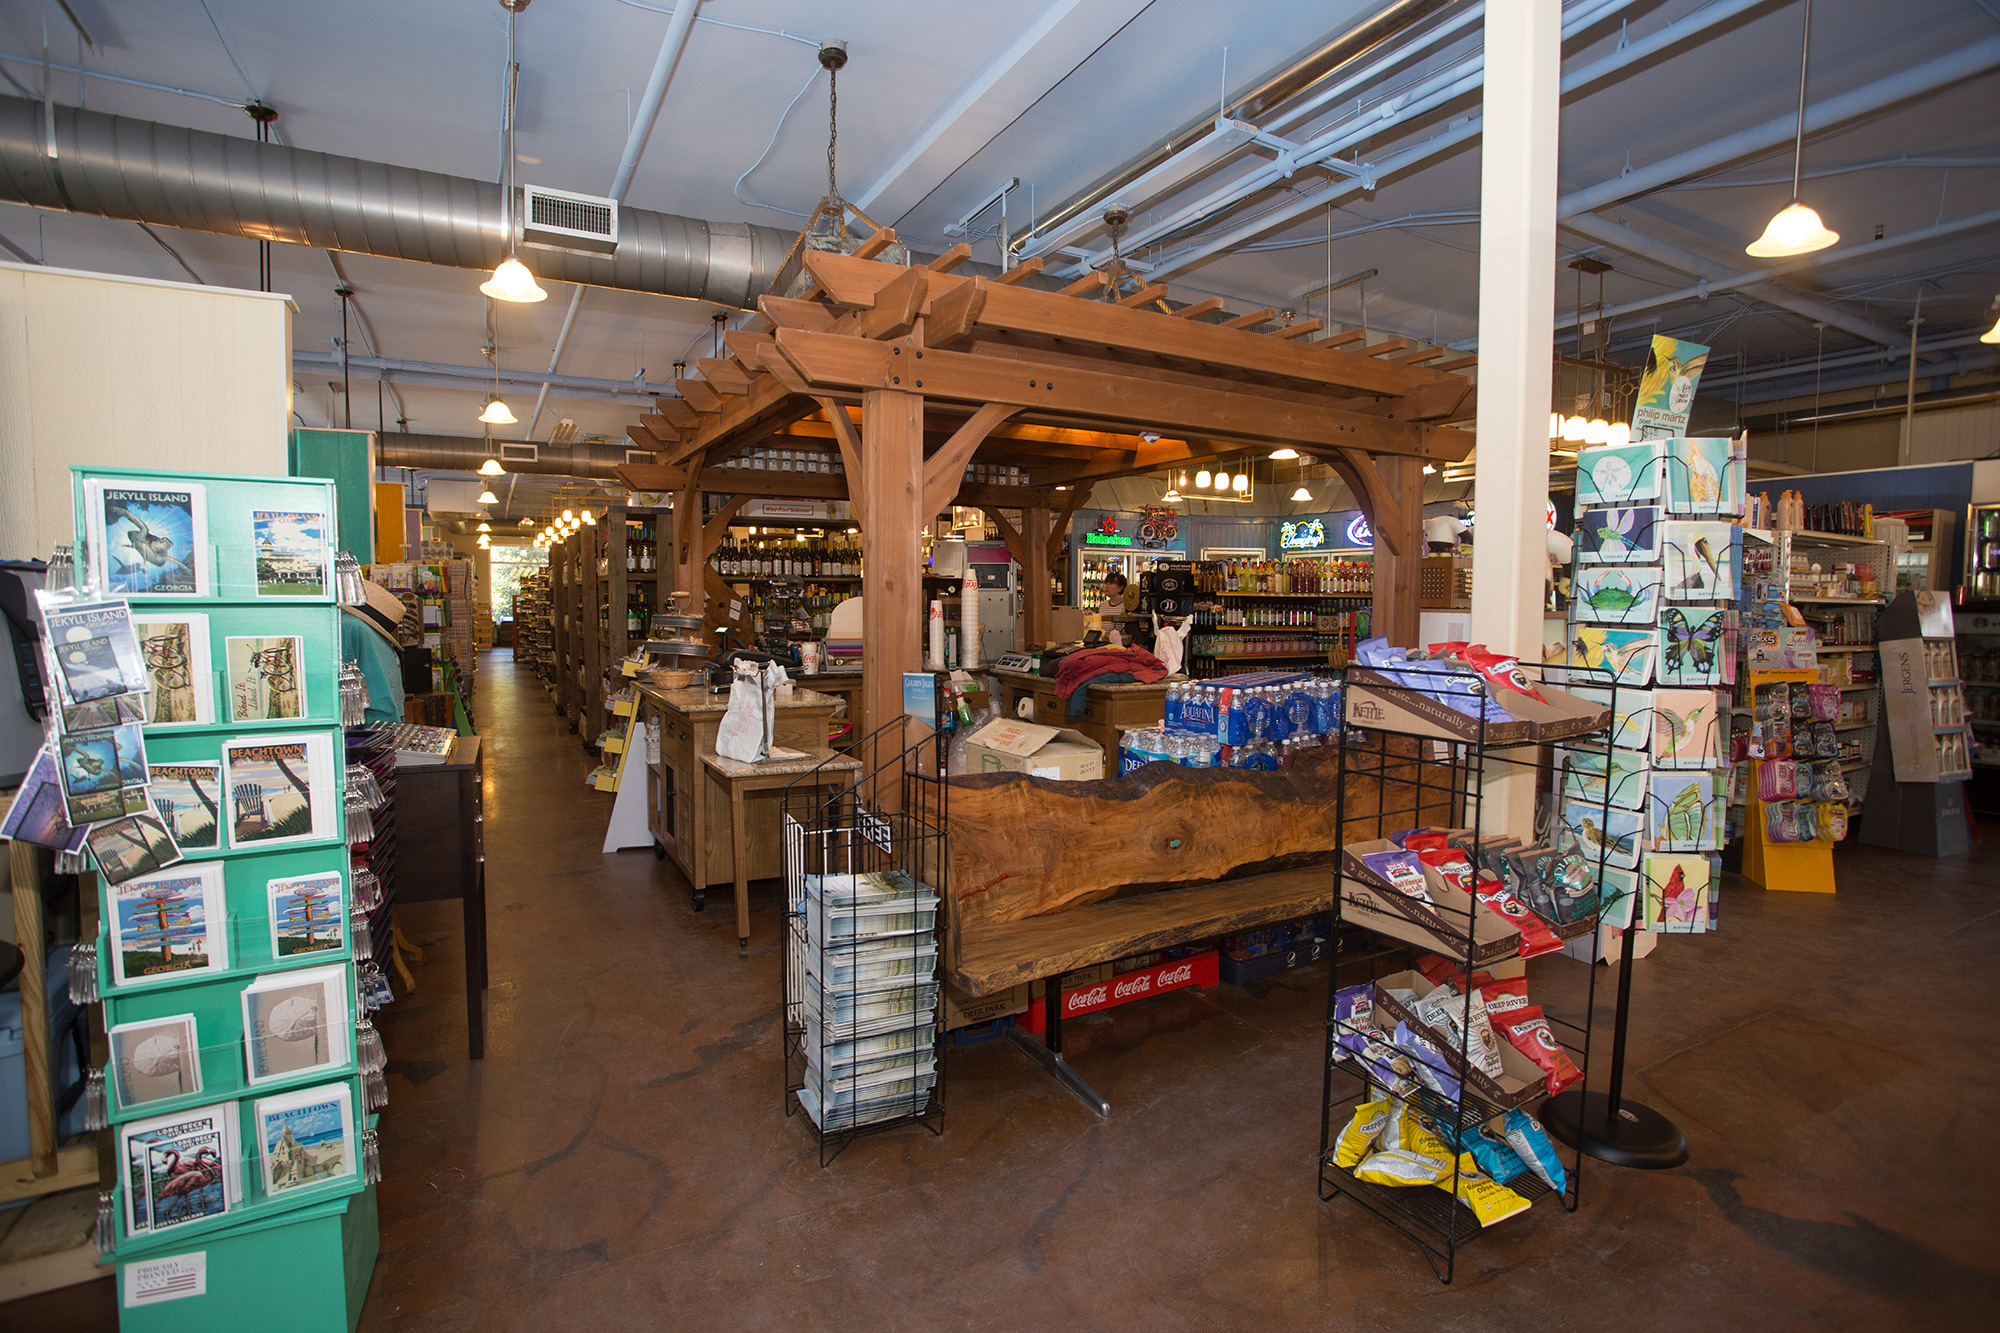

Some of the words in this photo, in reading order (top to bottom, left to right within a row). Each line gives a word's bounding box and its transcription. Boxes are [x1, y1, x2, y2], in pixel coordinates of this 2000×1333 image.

[1637, 408, 1660, 420] philip
[1662, 413, 1686, 424] martz
[106, 491, 146, 502] JEKYLL
[149, 492, 189, 504] ISLAND
[254, 512, 284, 520] JEKYLL
[286, 513, 319, 522] ISLAND
[1086, 532, 1132, 546] Heineken
[50, 615, 86, 628] JEKYLL
[87, 610, 127, 622] ISLAND
[85, 620, 119, 628] GEORGIA
[1899, 652, 1916, 695] JERGENS
[905, 678, 921, 688] GOLDEN
[922, 679, 934, 688] ISLES
[238, 692, 248, 717] Biked
[1352, 701, 1385, 720] KETTLE
[1180, 702, 1214, 724] AQUAFINA
[230, 745, 303, 758] BEACHTOWN
[252, 753, 275, 761] JEKYLL
[277, 751, 302, 759] ISLAND
[150, 768, 215, 777] BEACHTOWN
[1554, 854, 1584, 876] DIRTY
[119, 882, 154, 895] JEKYLL
[160, 878, 200, 888] ISLAND
[277, 882, 304, 892] JEKYLL
[1405, 878, 1423, 886] Vinegar
[292, 943, 329, 954] GEORGIA
[143, 960, 192, 975] GEORGIA
[1075, 973, 1093, 983] PARK
[1068, 986, 1108, 1010] Coca-Cola
[1114, 975, 1151, 998] Coca-Cola
[1157, 964, 1192, 987] Coca-Cola
[963, 1009, 984, 1019] DEER
[985, 1003, 1006, 1013] PARK
[1488, 1002, 1506, 1010] DEEP
[1506, 998, 1528, 1008] RIVER
[1391, 1005, 1413, 1026] great
[268, 1102, 338, 1122] BEACHTOWN
